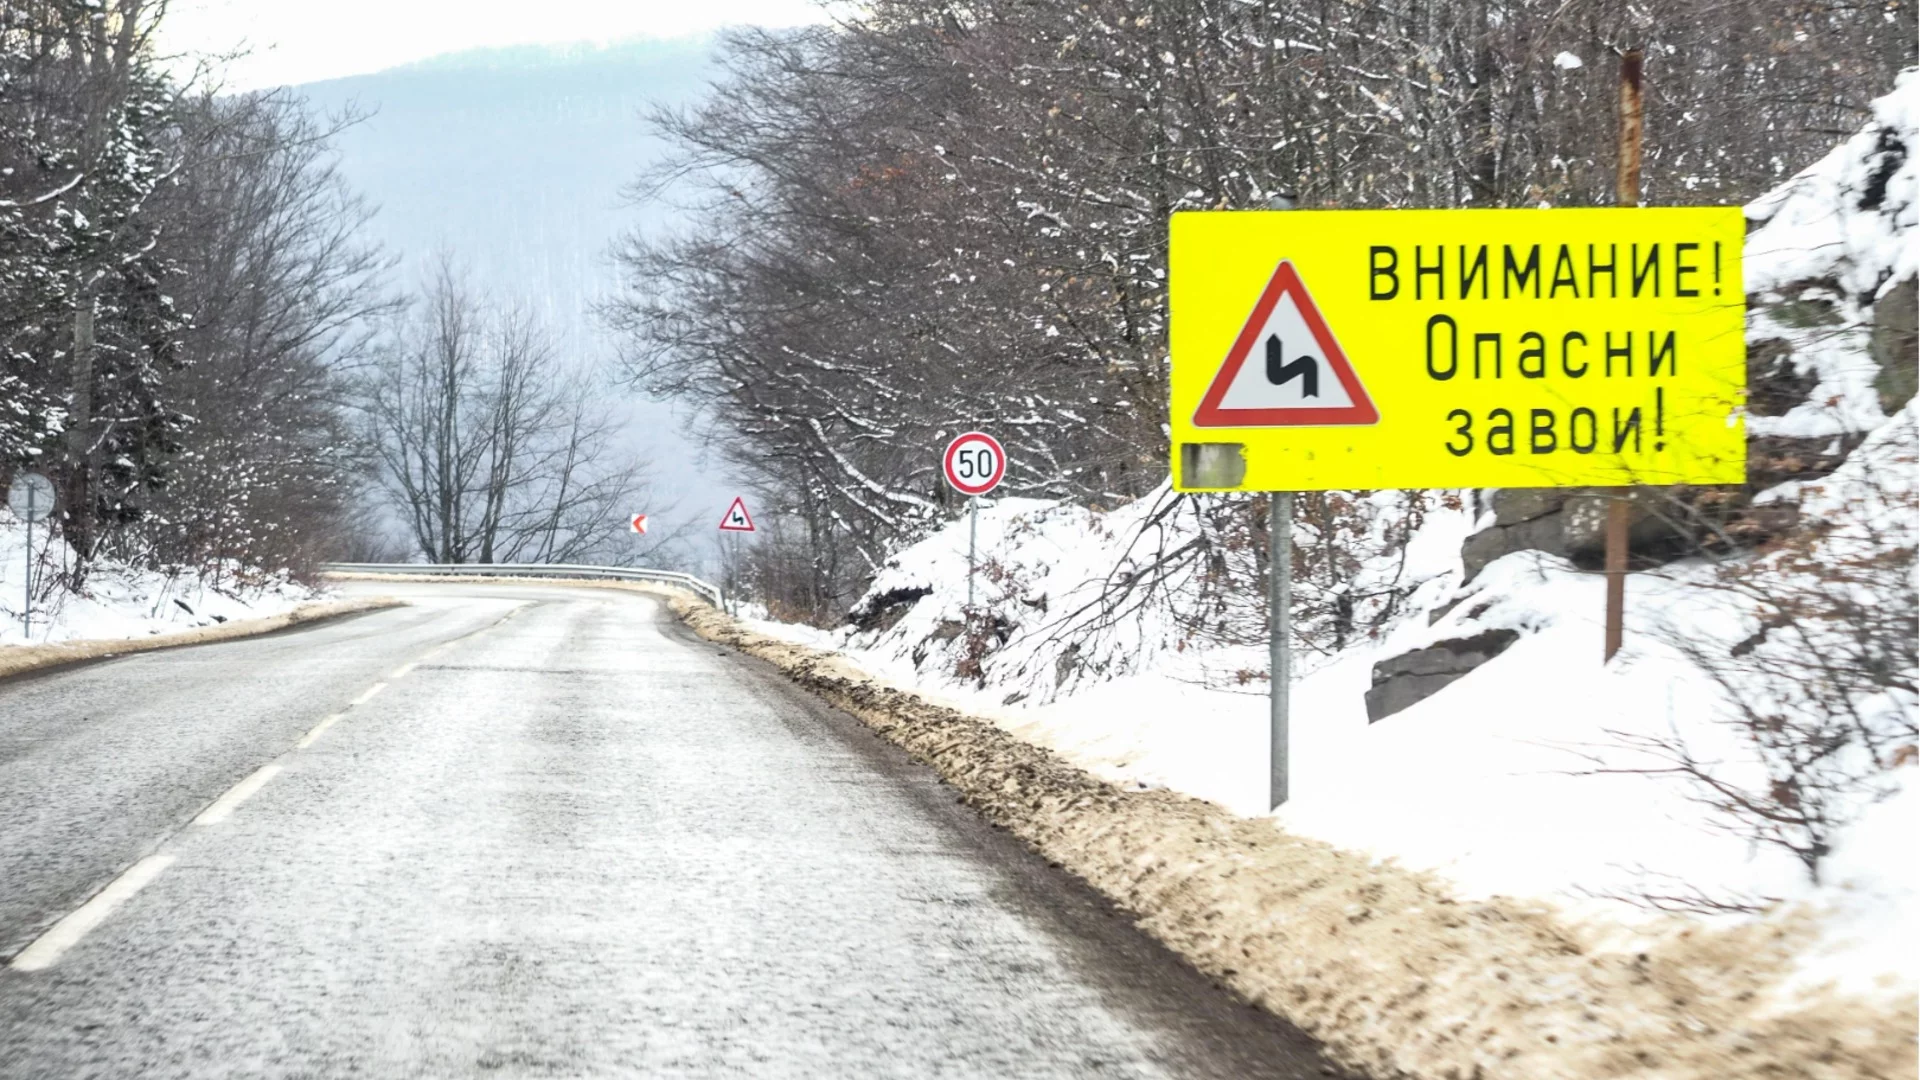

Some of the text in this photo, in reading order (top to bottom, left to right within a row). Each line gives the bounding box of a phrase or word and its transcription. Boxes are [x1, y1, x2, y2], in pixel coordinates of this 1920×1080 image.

[1369, 241, 1723, 301] ВНИМАНИЕ!
[1426, 314, 1677, 381] Опасни
[1445, 387, 1666, 457] завои!
[958, 449, 993, 479] 50
